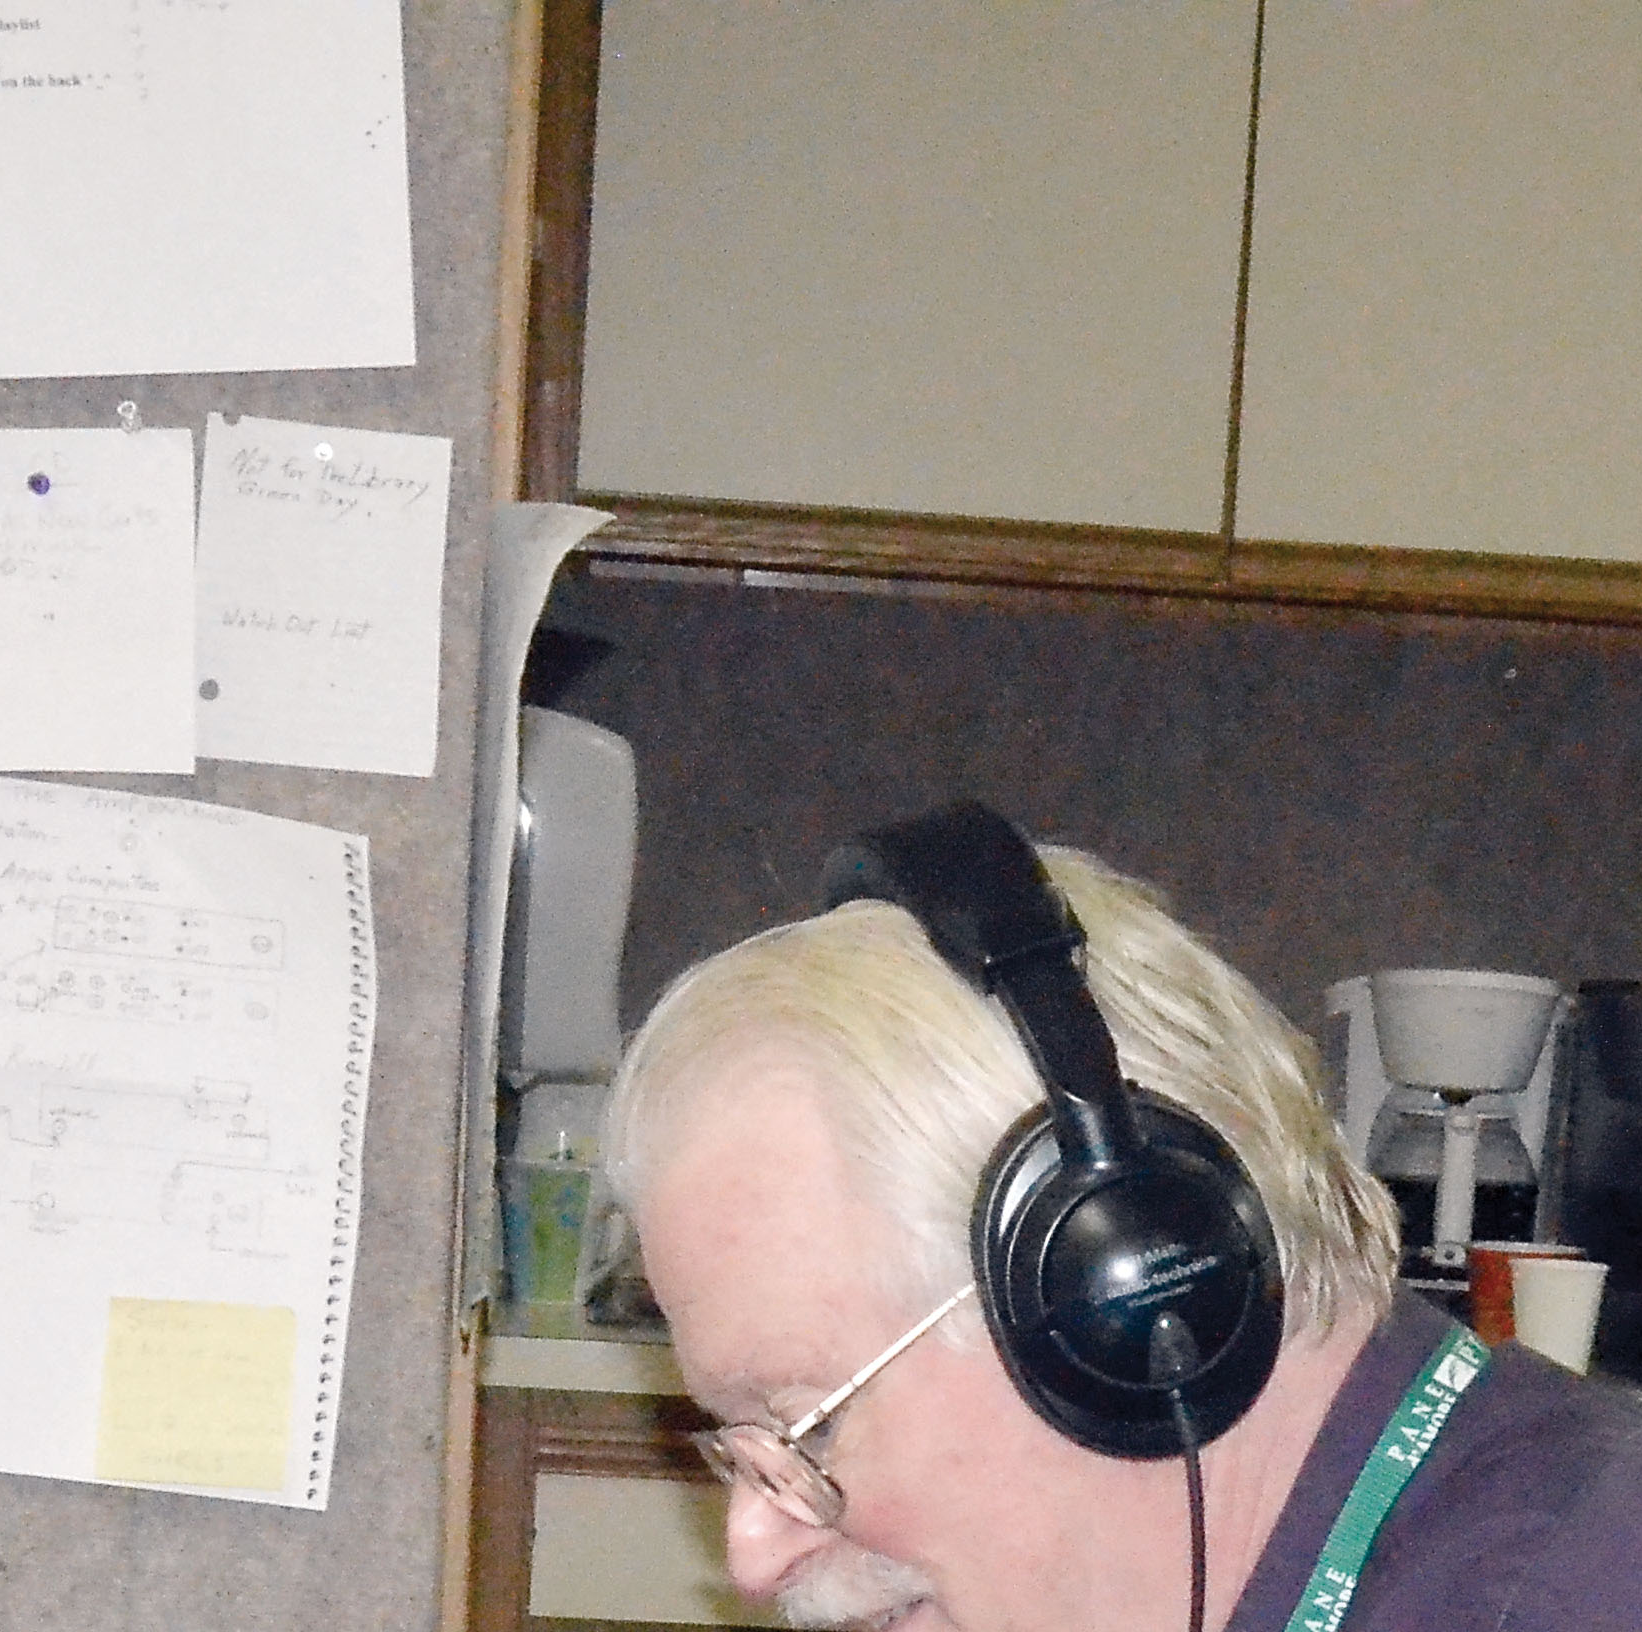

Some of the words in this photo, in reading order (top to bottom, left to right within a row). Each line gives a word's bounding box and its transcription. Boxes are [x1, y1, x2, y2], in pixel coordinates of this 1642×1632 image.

[22, 74, 44, 88] the
[48, 73, 82, 88] back
[1387, 1381, 1447, 1463] PANE
